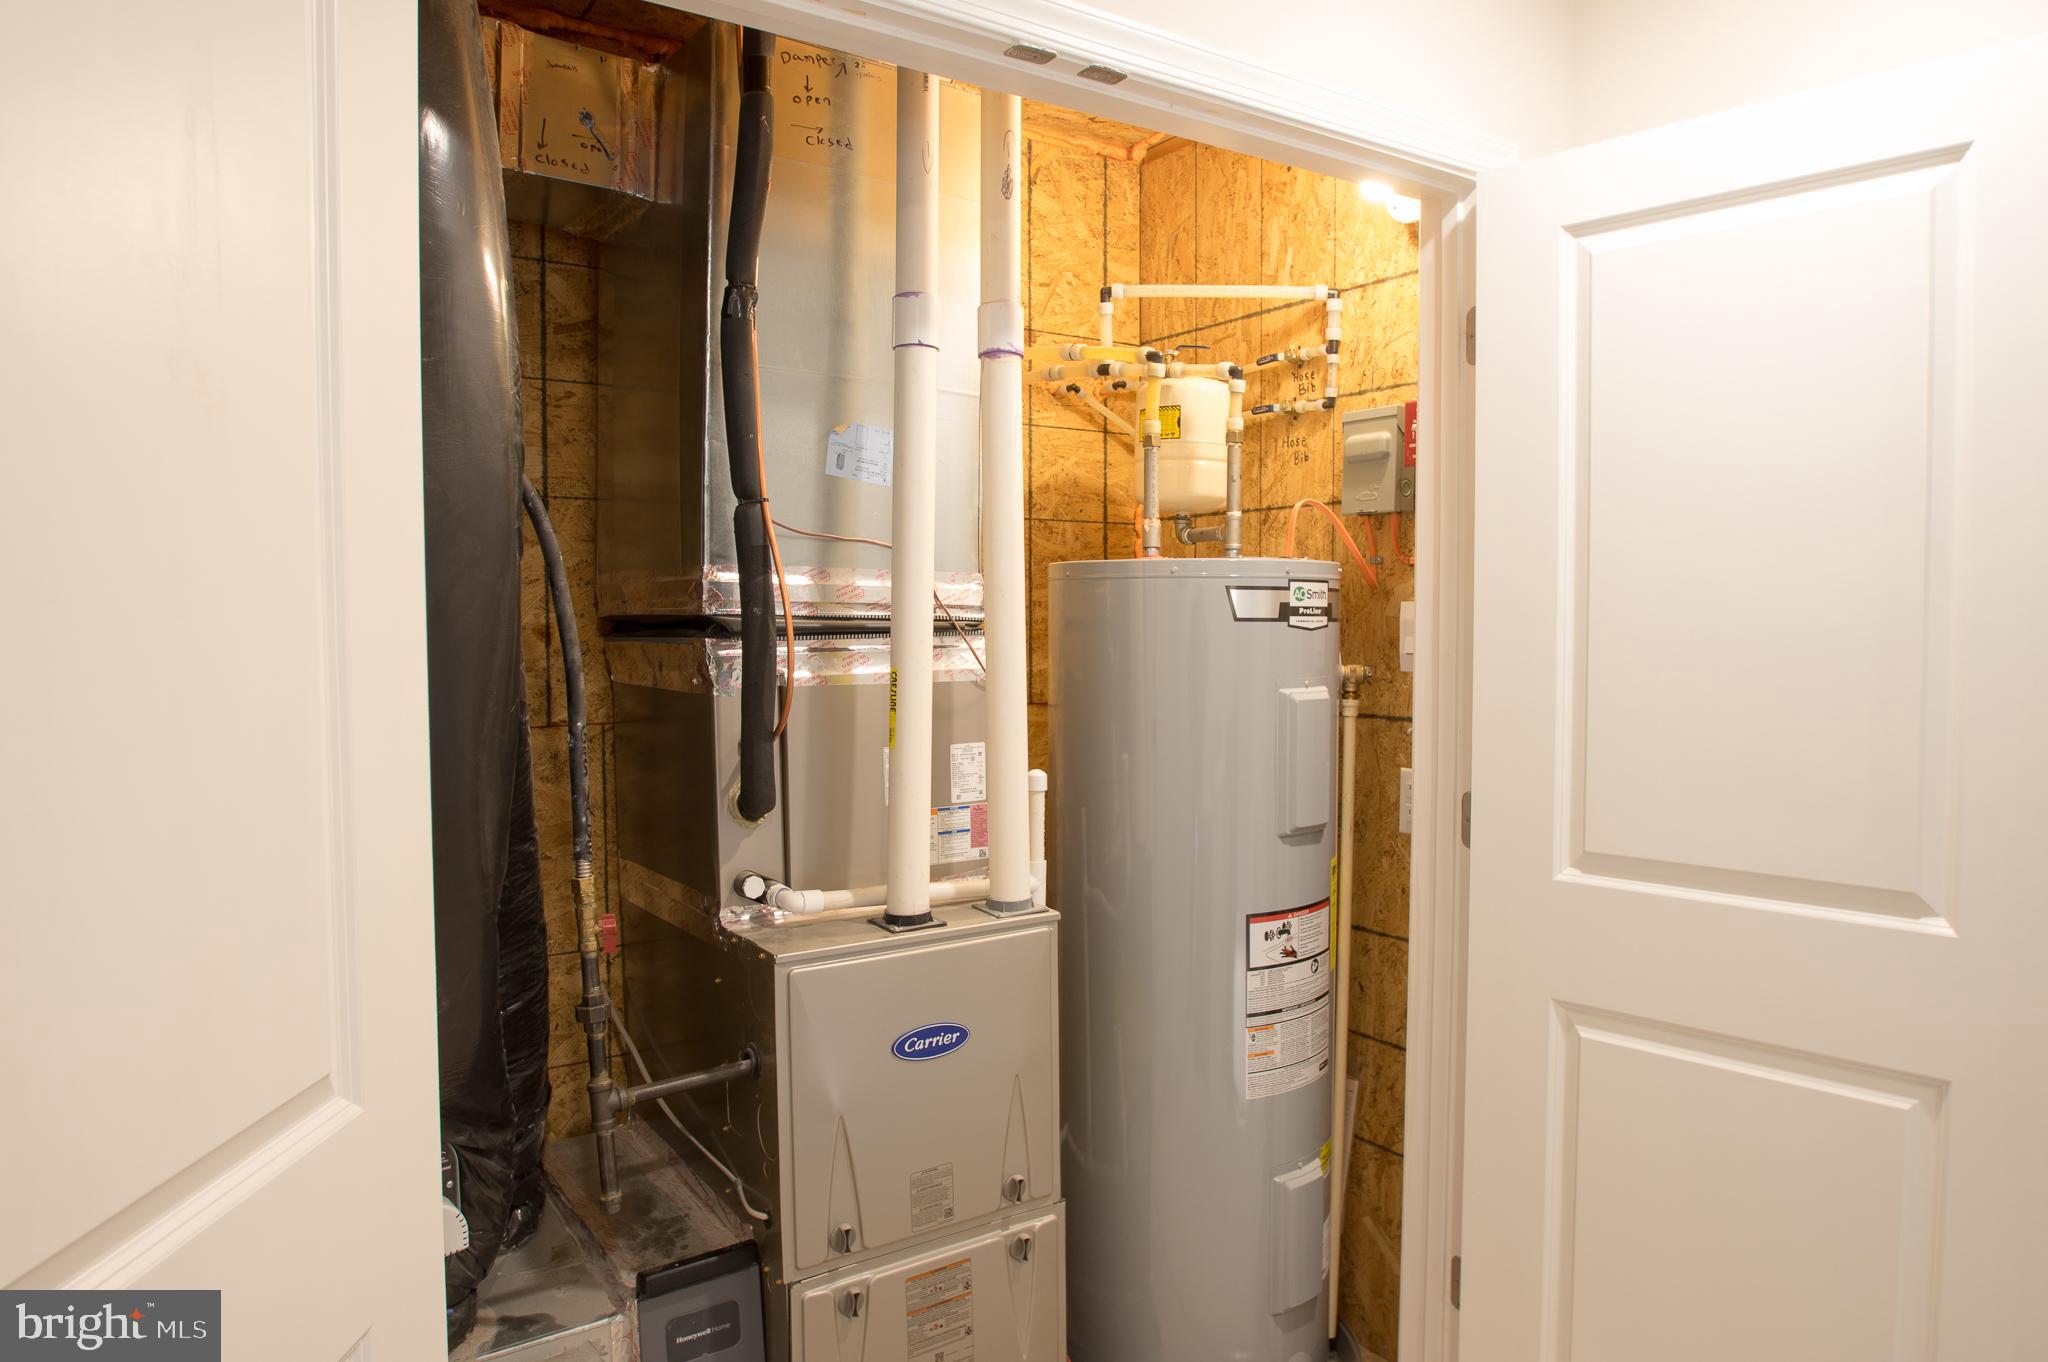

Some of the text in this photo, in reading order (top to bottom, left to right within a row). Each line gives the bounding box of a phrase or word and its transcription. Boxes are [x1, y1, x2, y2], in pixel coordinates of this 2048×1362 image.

[780, 51, 836, 69] Damper
[792, 95, 832, 107] open
[1282, 436, 1308, 449] Hose
[1306, 588, 1327, 600] Smith
[904, 1032, 960, 1052] Carrier
[675, 1322, 731, 1344] Honeywell Home
